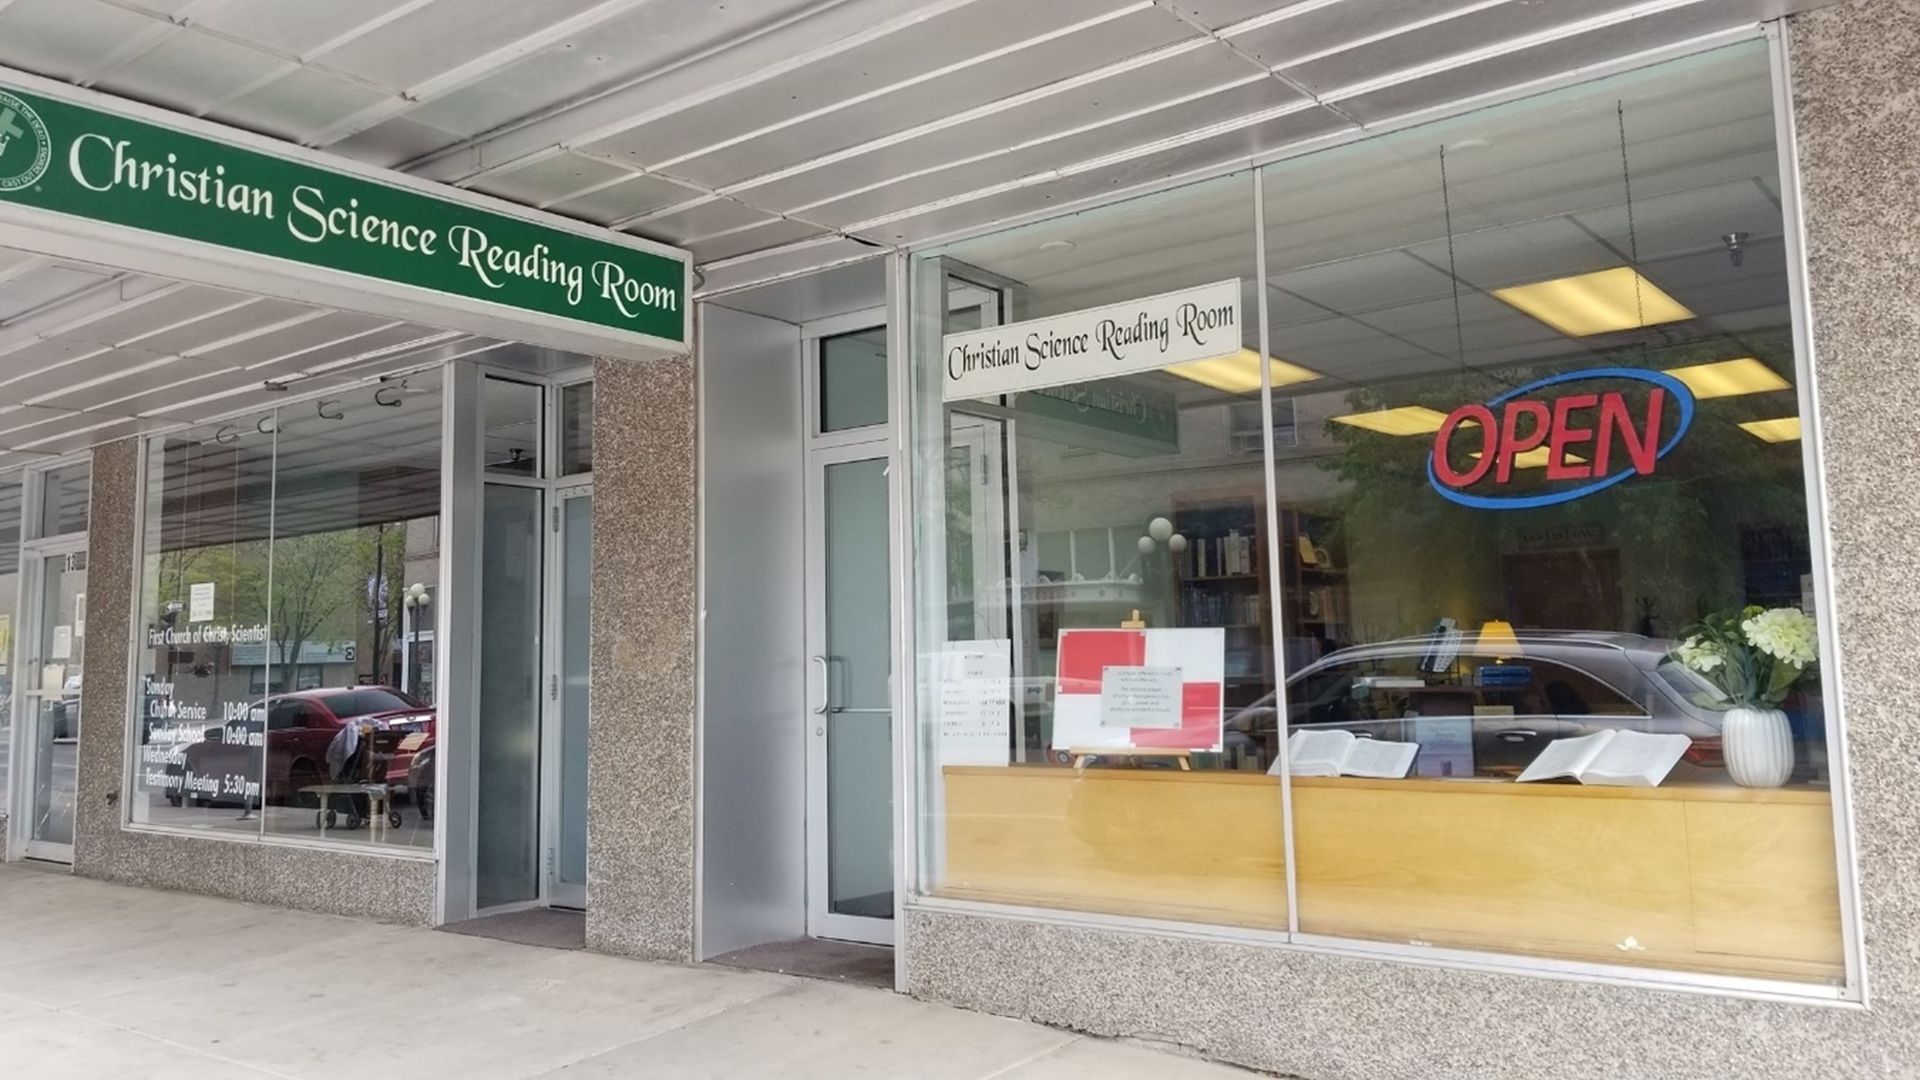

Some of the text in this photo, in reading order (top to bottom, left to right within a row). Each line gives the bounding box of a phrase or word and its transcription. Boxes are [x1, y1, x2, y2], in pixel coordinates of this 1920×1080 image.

[69, 133, 677, 318] Christian Science Reading Room
[948, 303, 1234, 380] Christian Science Reading Room
[1433, 388, 1664, 487] OPEN
[148, 623, 269, 646] First Church of Christ, Scientist
[146, 676, 175, 700] Sunday
[150, 698, 265, 721] Church Service 10:00 am
[148, 722, 263, 746] Sunday School 10:00 am
[143, 744, 187, 770] Wednesday
[145, 767, 259, 800] Testimony Meeting 5:30 pm
